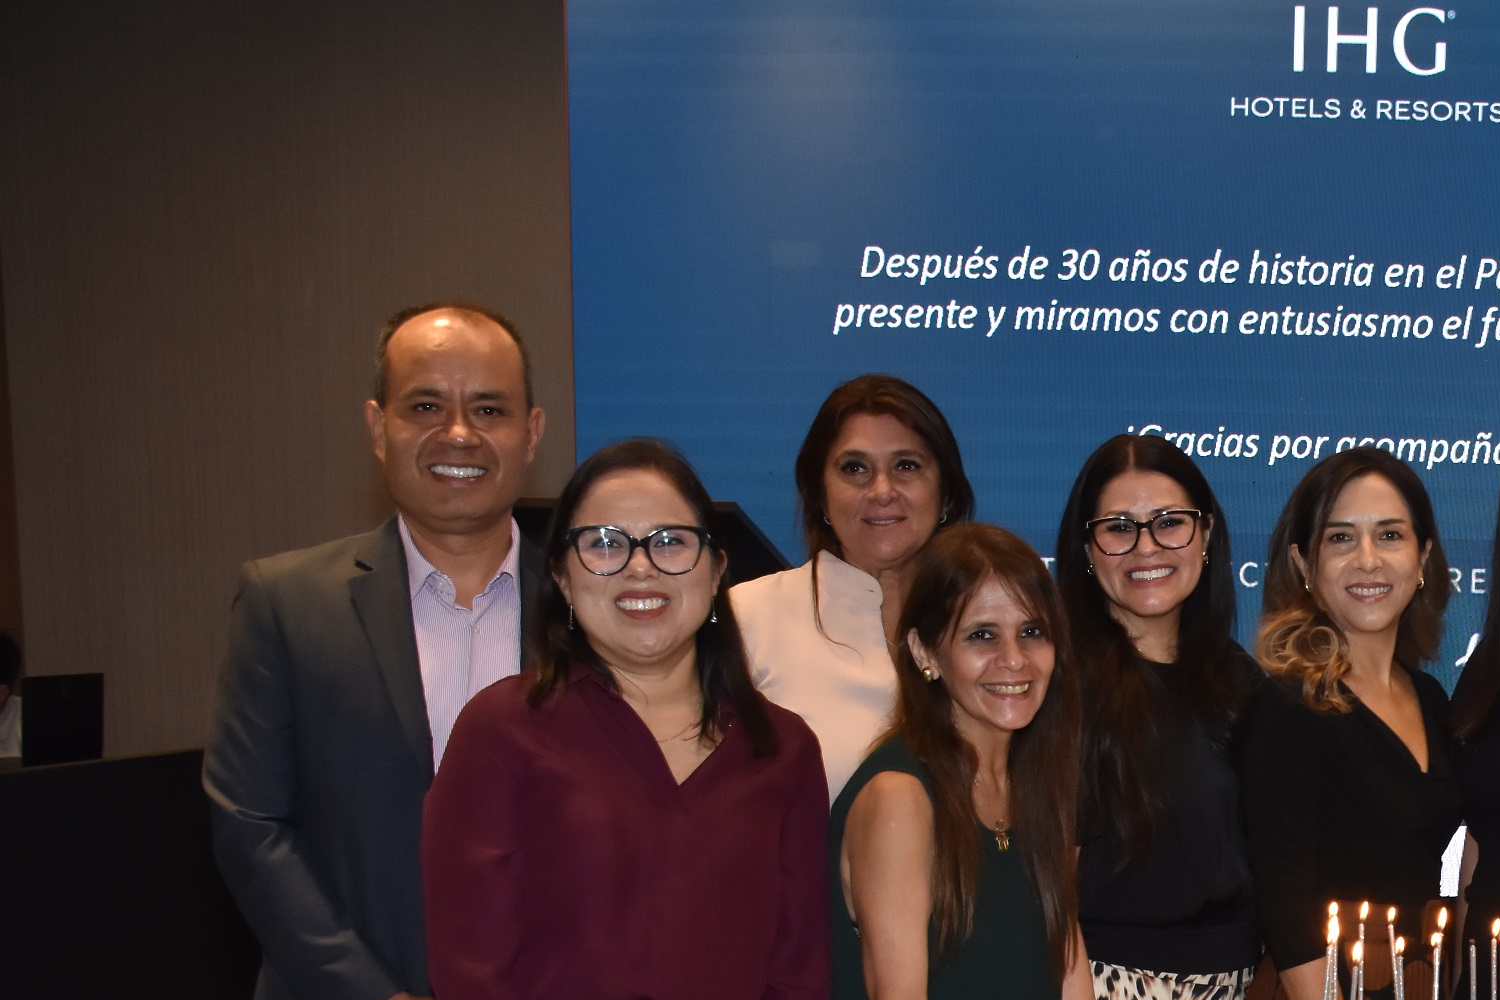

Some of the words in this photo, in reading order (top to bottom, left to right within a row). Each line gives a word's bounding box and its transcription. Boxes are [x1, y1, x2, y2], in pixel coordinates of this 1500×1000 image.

[1293, 5, 1447, 76] IHG
[1230, 96, 1341, 119] HOTELS
[1350, 98, 1367, 119] &
[860, 245, 1000, 286] Después
[1007, 245, 1049, 281] de
[1057, 248, 1101, 281] 30
[1108, 249, 1188, 283] años
[1198, 248, 1240, 284] de
[1248, 249, 1375, 287] historia
[1384, 262, 1425, 289] en
[1435, 255, 1468, 290] el
[832, 299, 978, 336] presente
[985, 304, 1006, 338] y
[1014, 299, 1161, 333] miramos
[1169, 307, 1229, 335] con
[1238, 304, 1434, 338] entusiasmo
[1442, 305, 1474, 340] el
[1127, 424, 1260, 458] acias
[1268, 433, 1330, 466] por
